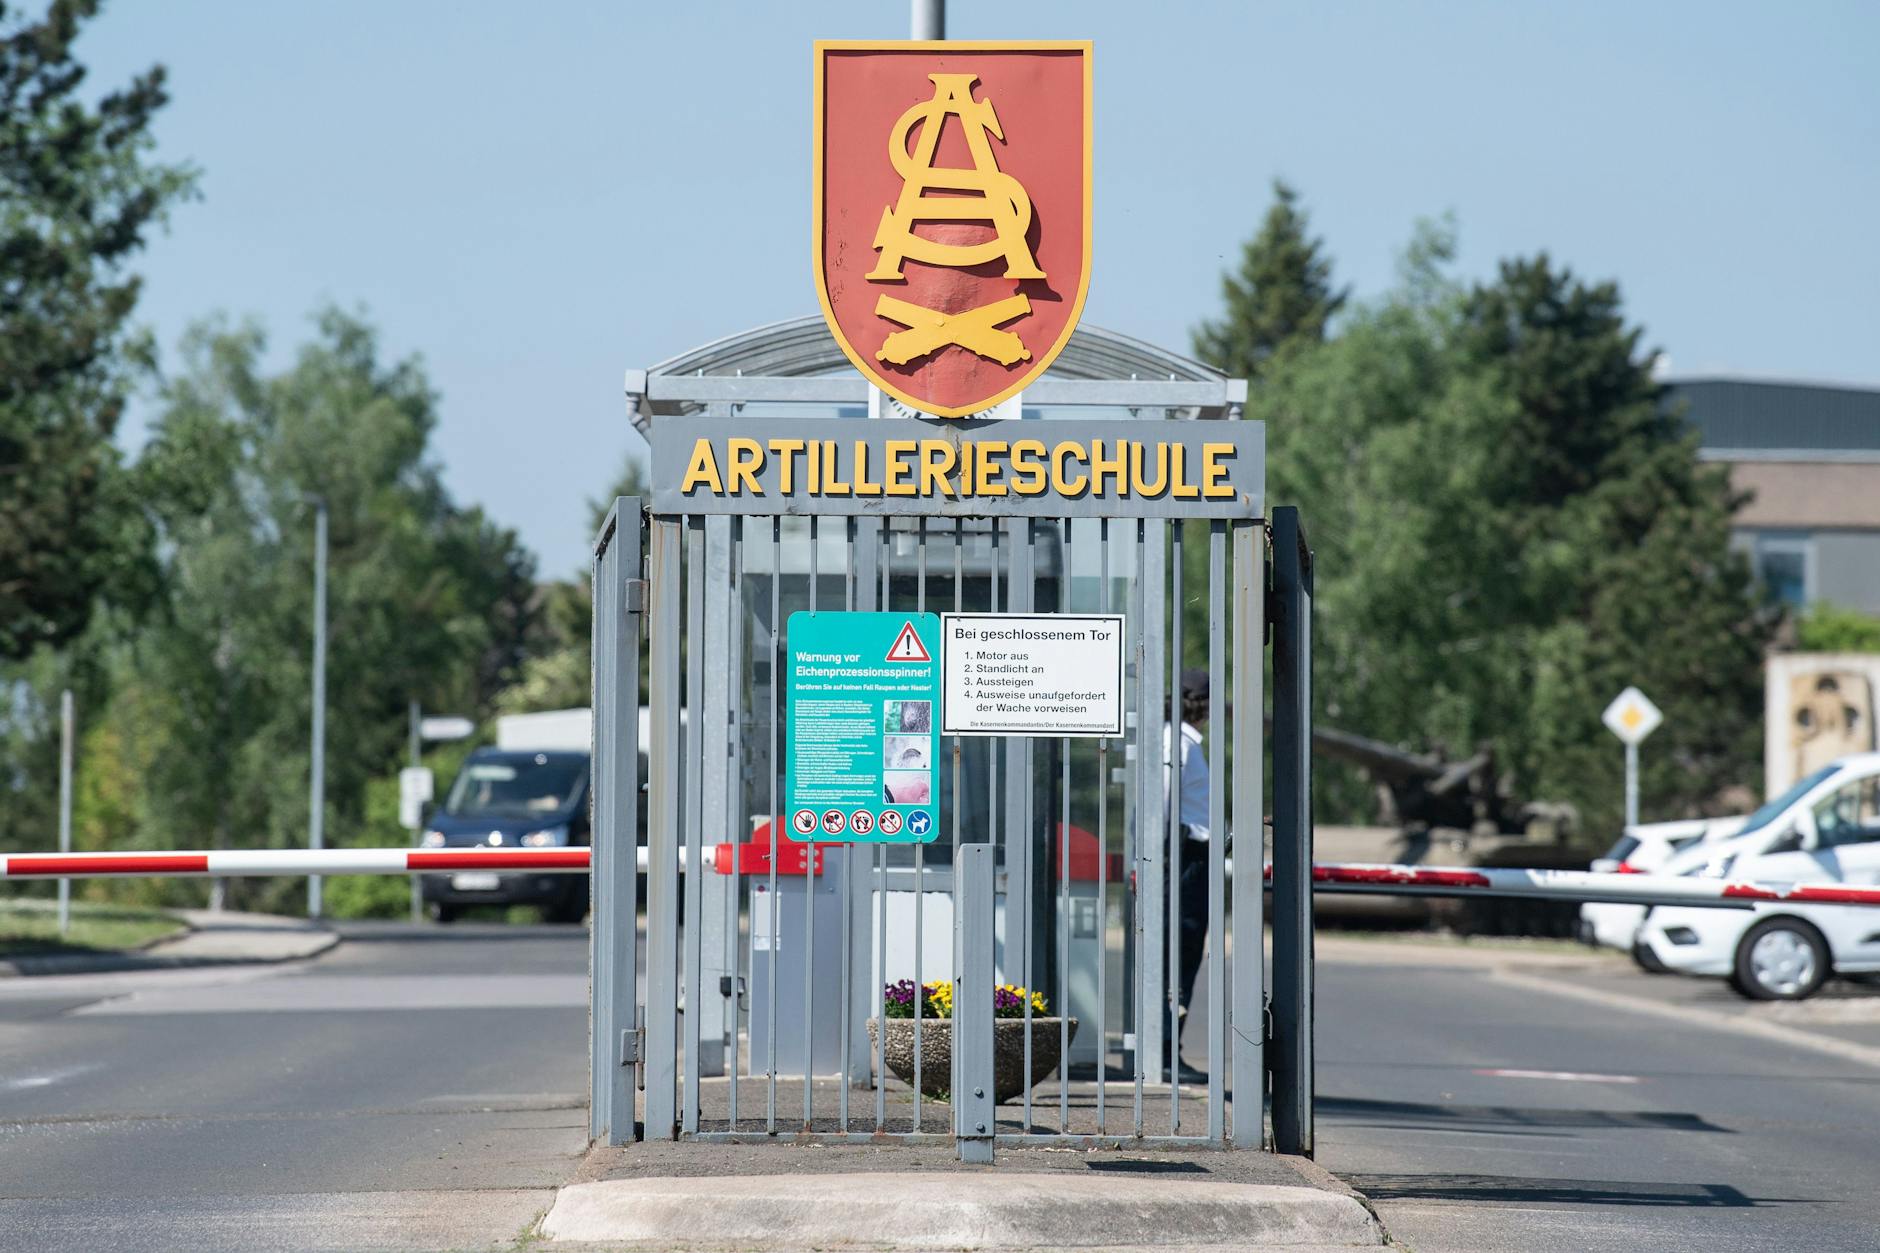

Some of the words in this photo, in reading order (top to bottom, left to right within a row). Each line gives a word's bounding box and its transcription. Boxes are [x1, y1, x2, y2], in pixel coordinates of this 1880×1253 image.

[681, 438, 1236, 498] ARTILLERIESCHULE
[955, 628, 976, 639] Bei
[981, 629, 1085, 641] geschlossenem
[1090, 630, 1111, 640] Tor
[796, 652, 841, 664] Warnung
[844, 654, 860, 662] vor
[964, 652, 973, 660] 1.
[976, 652, 1008, 660] Motor
[796, 666, 931, 678] Eichenprozessionsspinner!
[976, 664, 1028, 673] Standlicht
[976, 678, 1033, 687] Aussteigen
[964, 691, 973, 699] 4.
[976, 691, 1026, 699] Ausweise
[1029, 691, 1106, 701] unaufgefordert
[976, 704, 993, 712] der
[996, 704, 1031, 712] Wache
[1034, 704, 1087, 713] vorweisen
